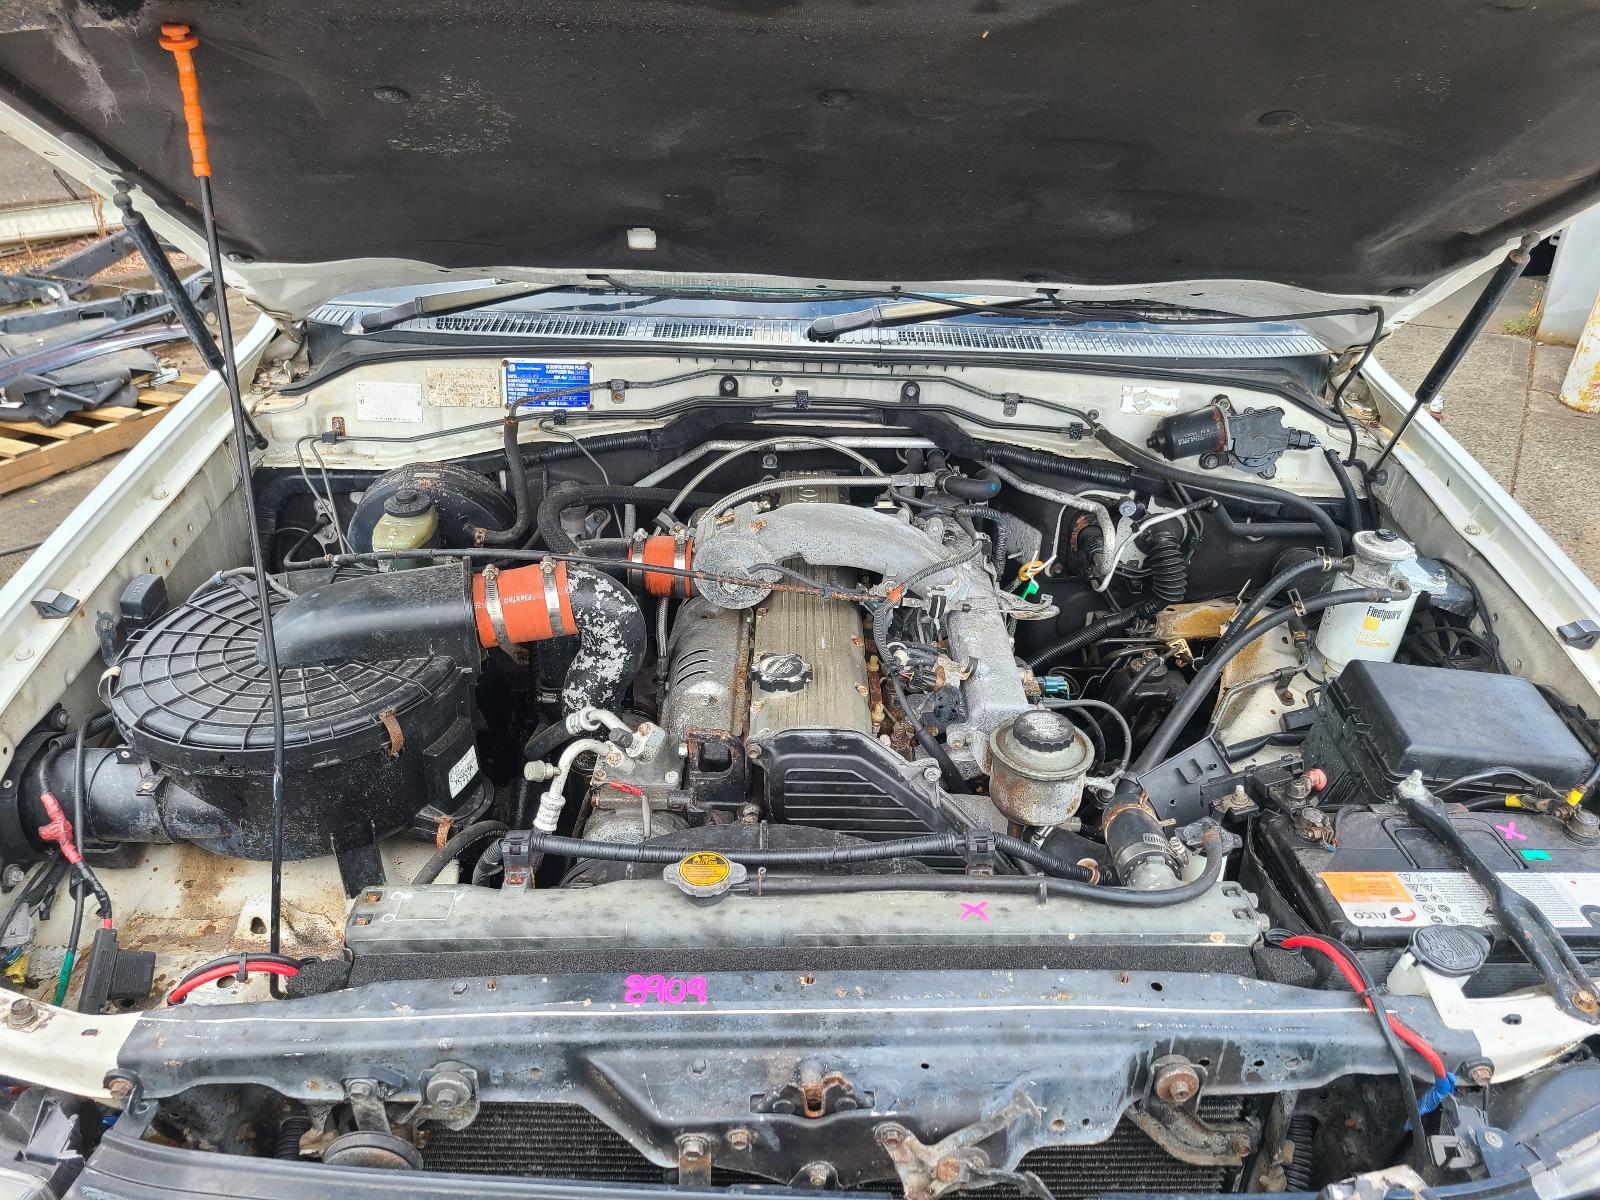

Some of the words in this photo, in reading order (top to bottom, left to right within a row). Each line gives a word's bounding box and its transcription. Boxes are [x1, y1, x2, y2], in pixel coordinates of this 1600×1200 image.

[503, 594, 532, 604] Flexfab
[1366, 605, 1402, 621] Fleetguard
[1353, 911, 1387, 920] ALCO
[623, 973, 707, 1005] 8909
